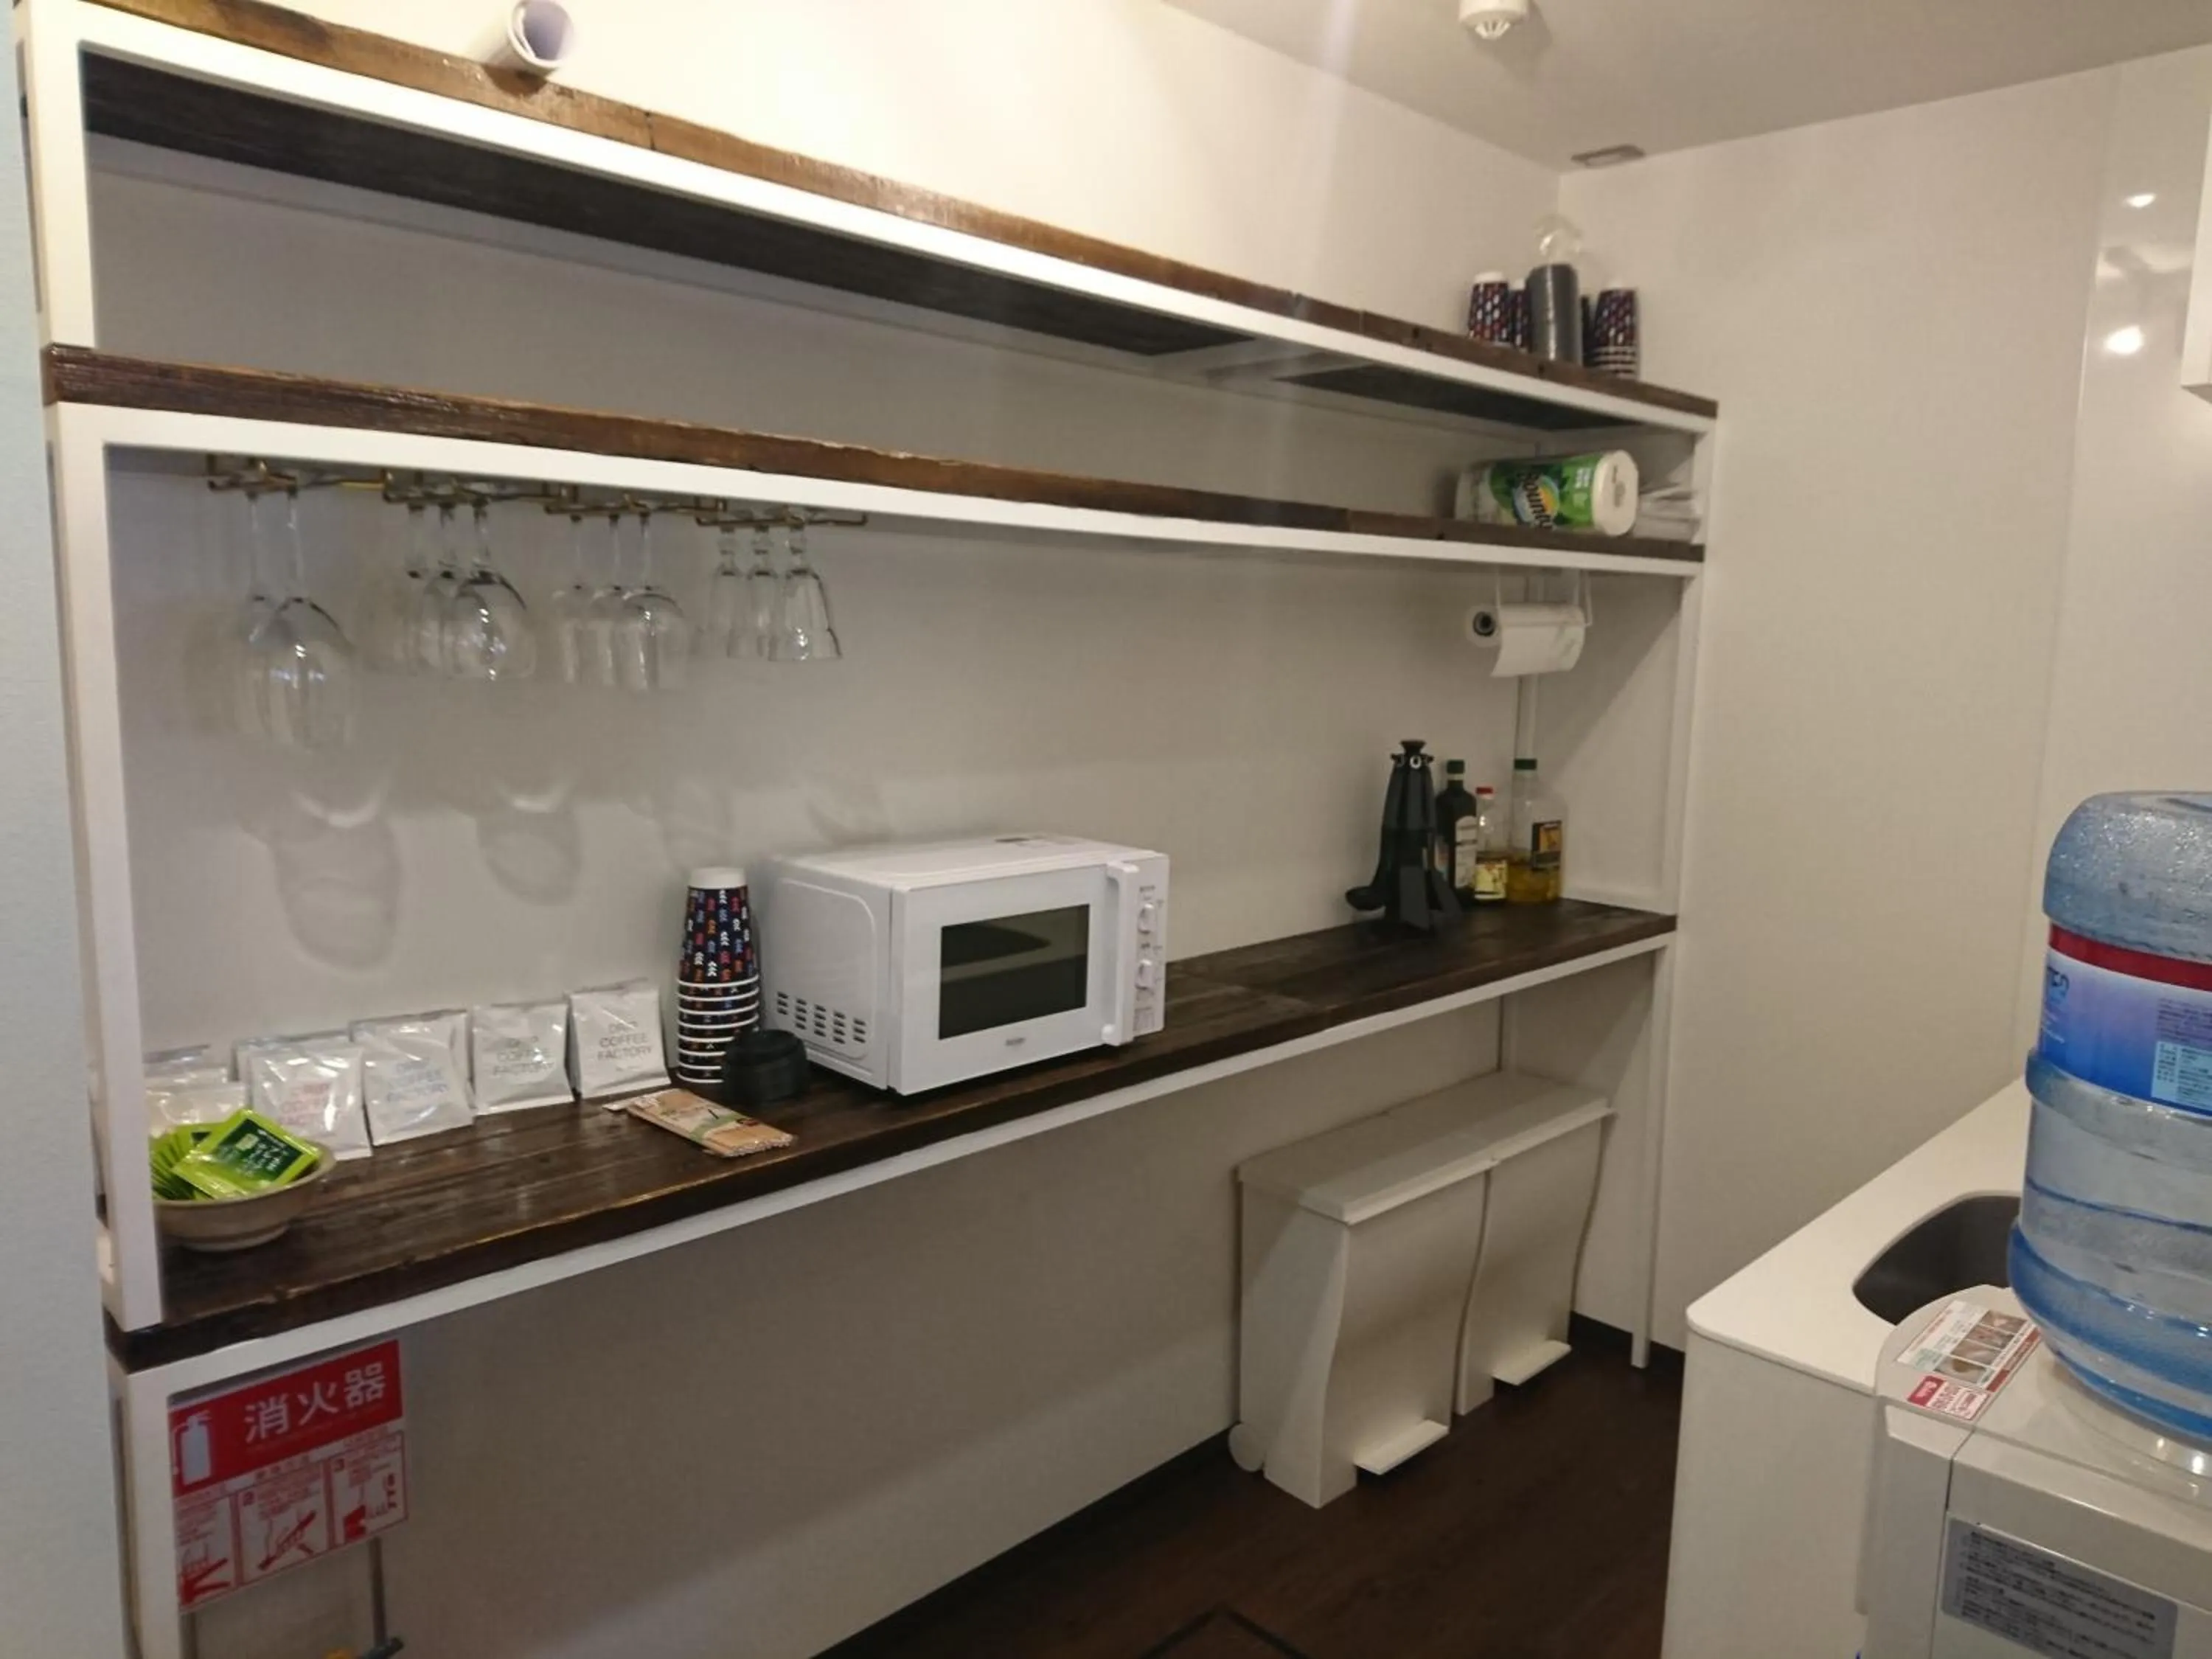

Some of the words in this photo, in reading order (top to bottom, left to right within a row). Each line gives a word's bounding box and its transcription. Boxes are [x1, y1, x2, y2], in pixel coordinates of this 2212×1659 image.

[608, 1020, 639, 1034] DRP
[599, 1033, 649, 1048] COFFEE
[597, 1046, 653, 1060] FACTORY
[244, 1362, 387, 1444] 消火器
